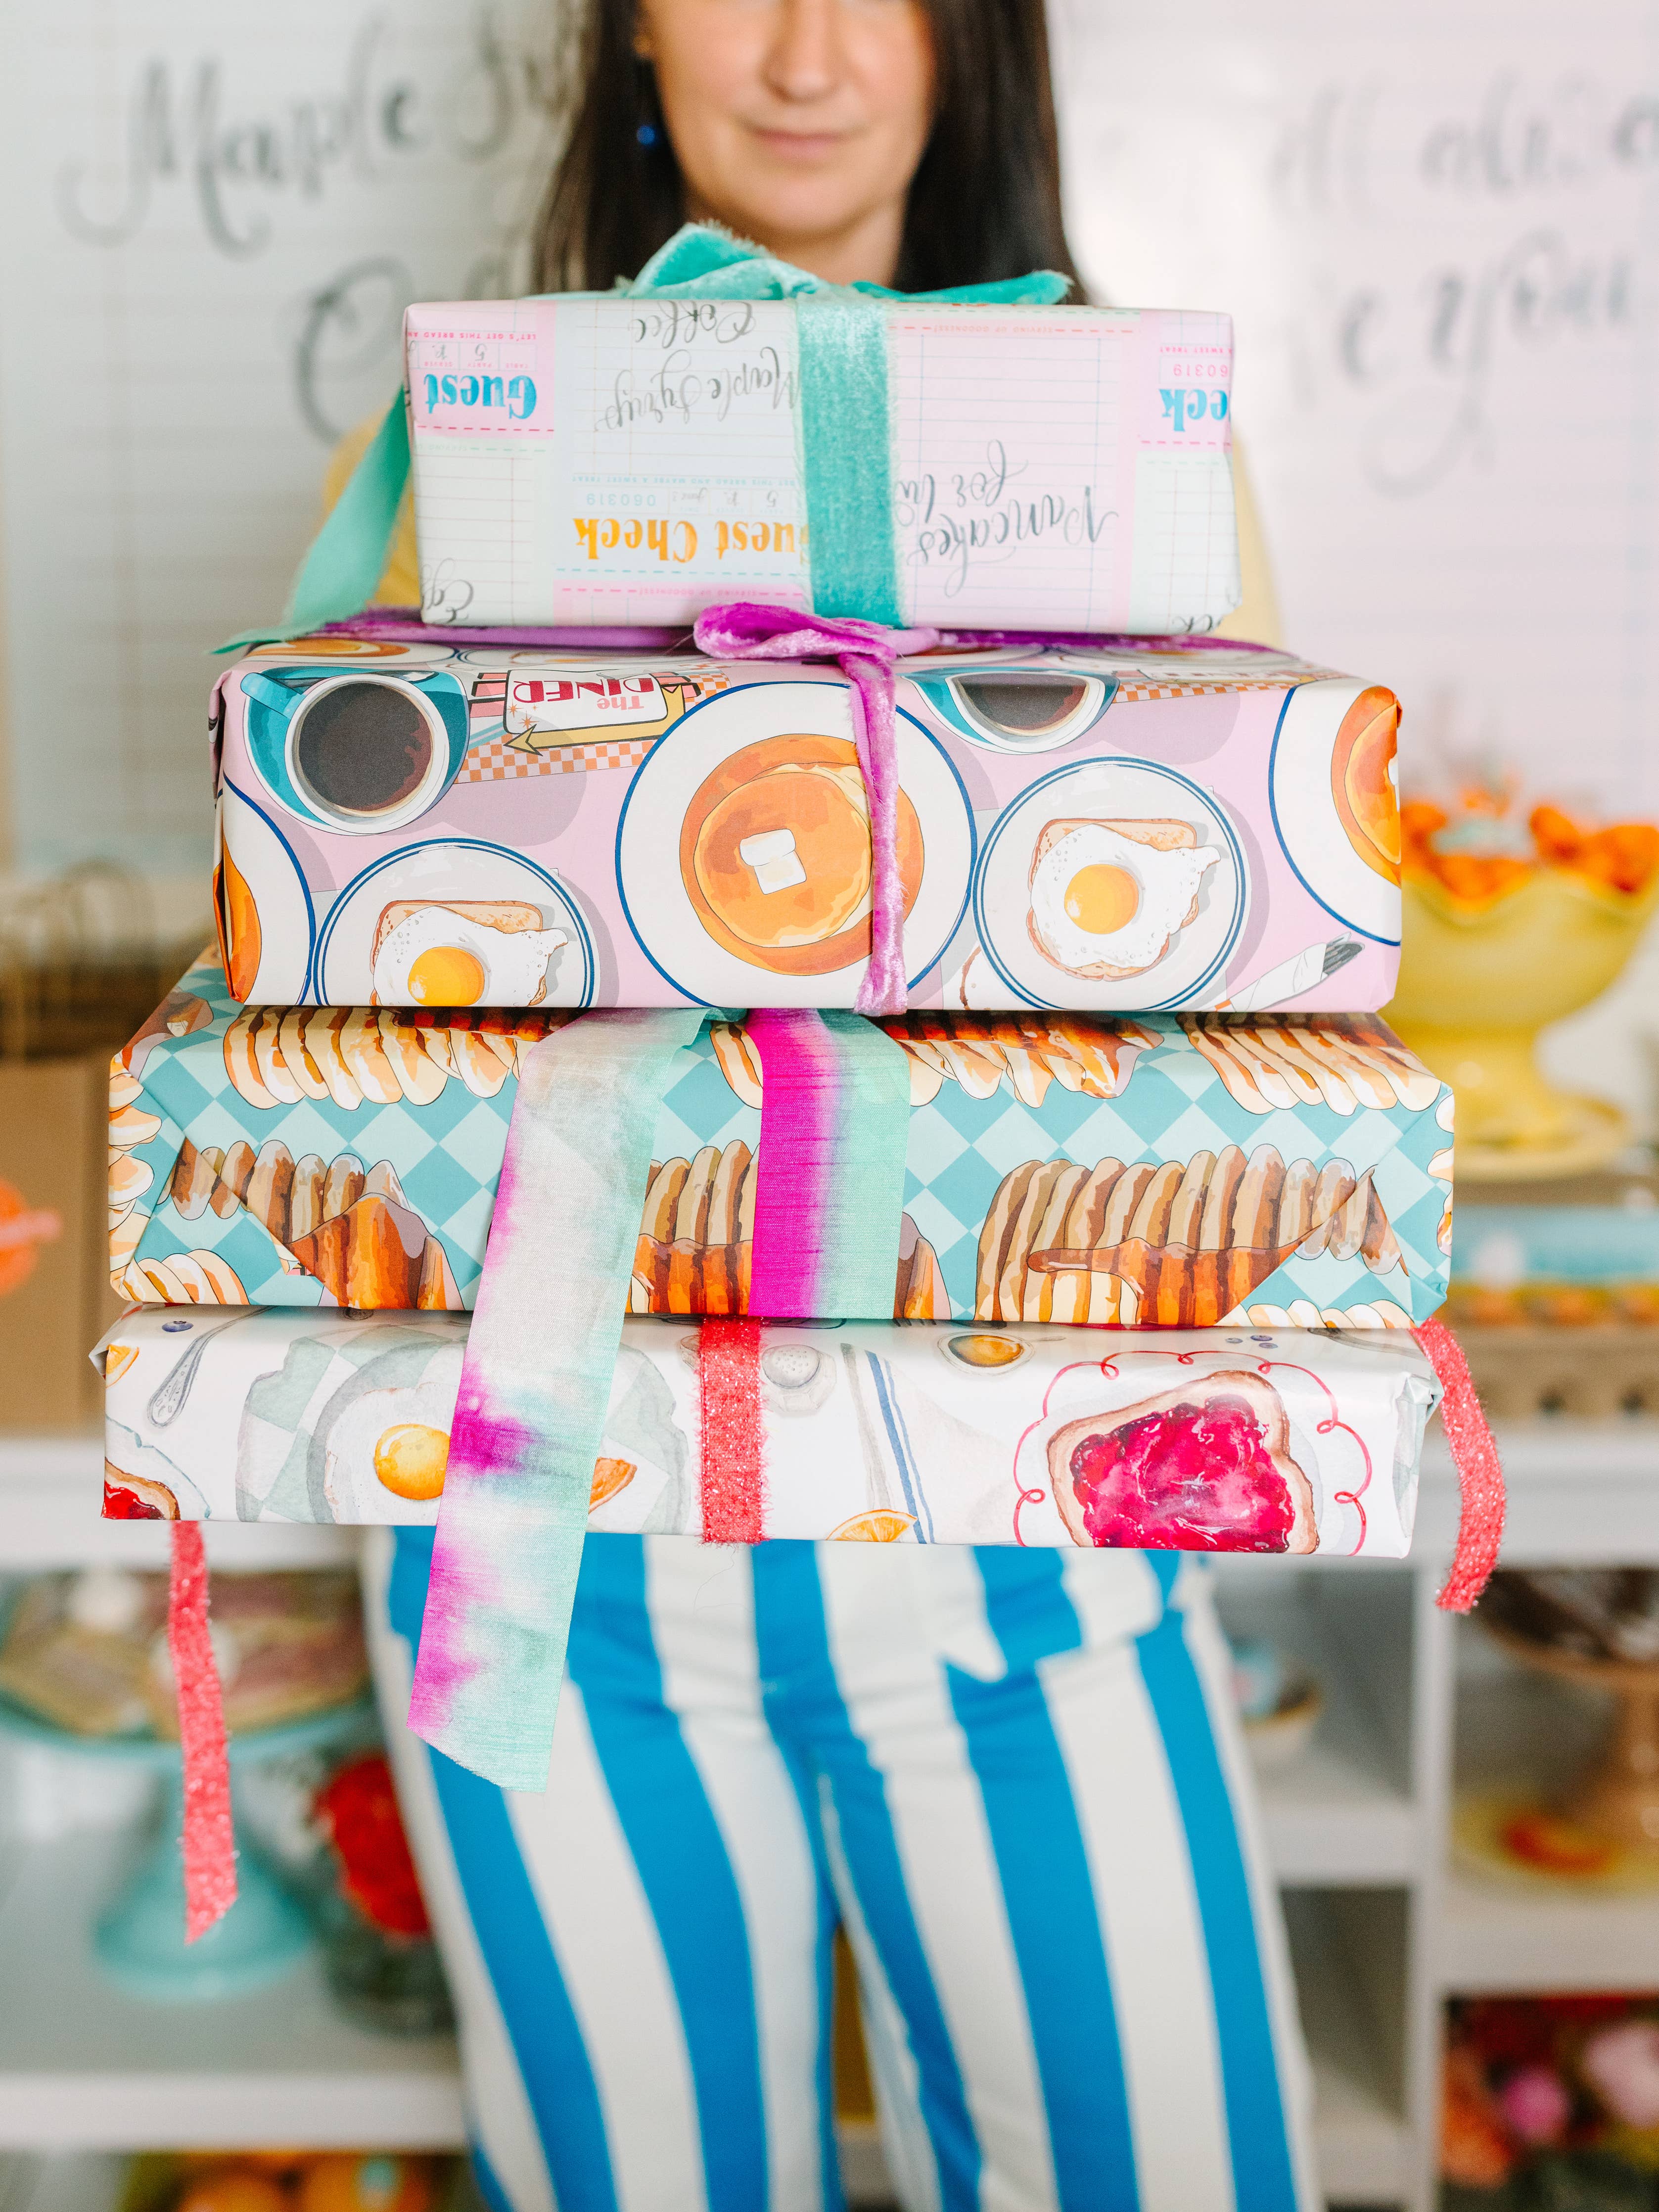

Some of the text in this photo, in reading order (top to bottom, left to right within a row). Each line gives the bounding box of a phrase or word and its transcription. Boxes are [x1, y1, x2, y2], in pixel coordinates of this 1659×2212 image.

[628, 300, 756, 349] Coffee
[594, 346, 799, 432] Maple Syrup
[1172, 364, 1229, 377] 60319
[422, 373, 538, 420] Guest
[1158, 388, 1230, 432] eck
[951, 439, 1028, 507] for
[586, 493, 656, 507] 060319
[572, 518, 698, 564] Check
[906, 486, 1119, 599] Pancakes
[512, 678, 654, 704] DINER
[597, 695, 645, 711] The
